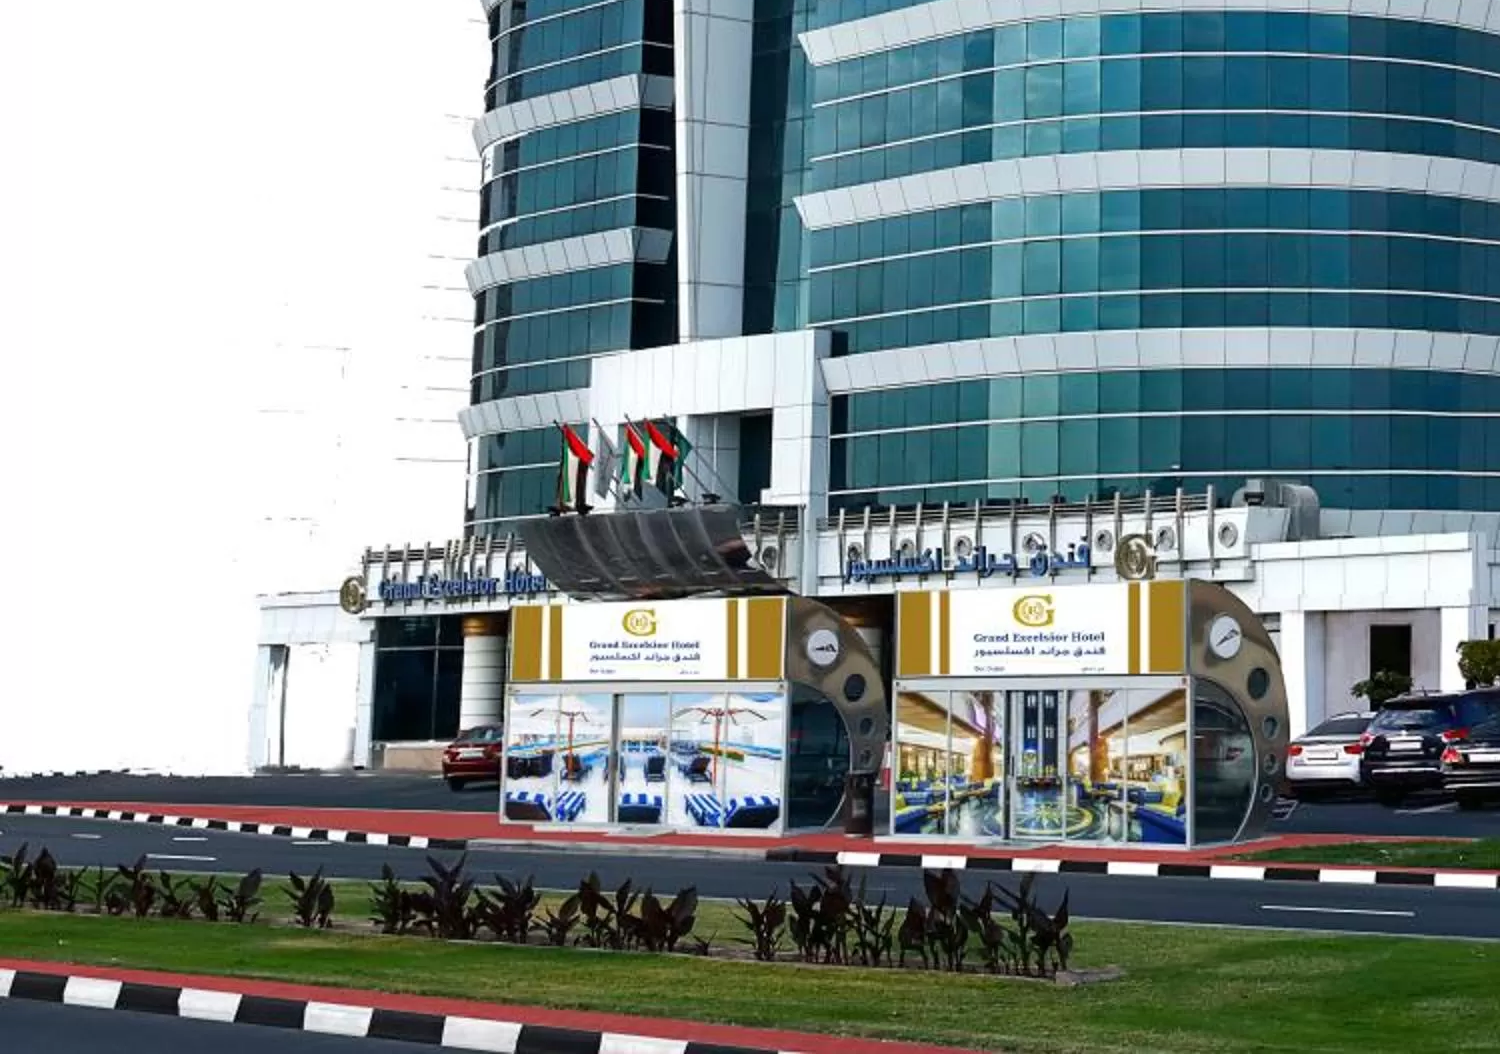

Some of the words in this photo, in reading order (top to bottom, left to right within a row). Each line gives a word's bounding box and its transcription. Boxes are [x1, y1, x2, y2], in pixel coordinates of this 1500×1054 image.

[973, 633, 1009, 643] Grand
[1013, 632, 1068, 643] Excelsior
[1071, 632, 1105, 643] Hotel
